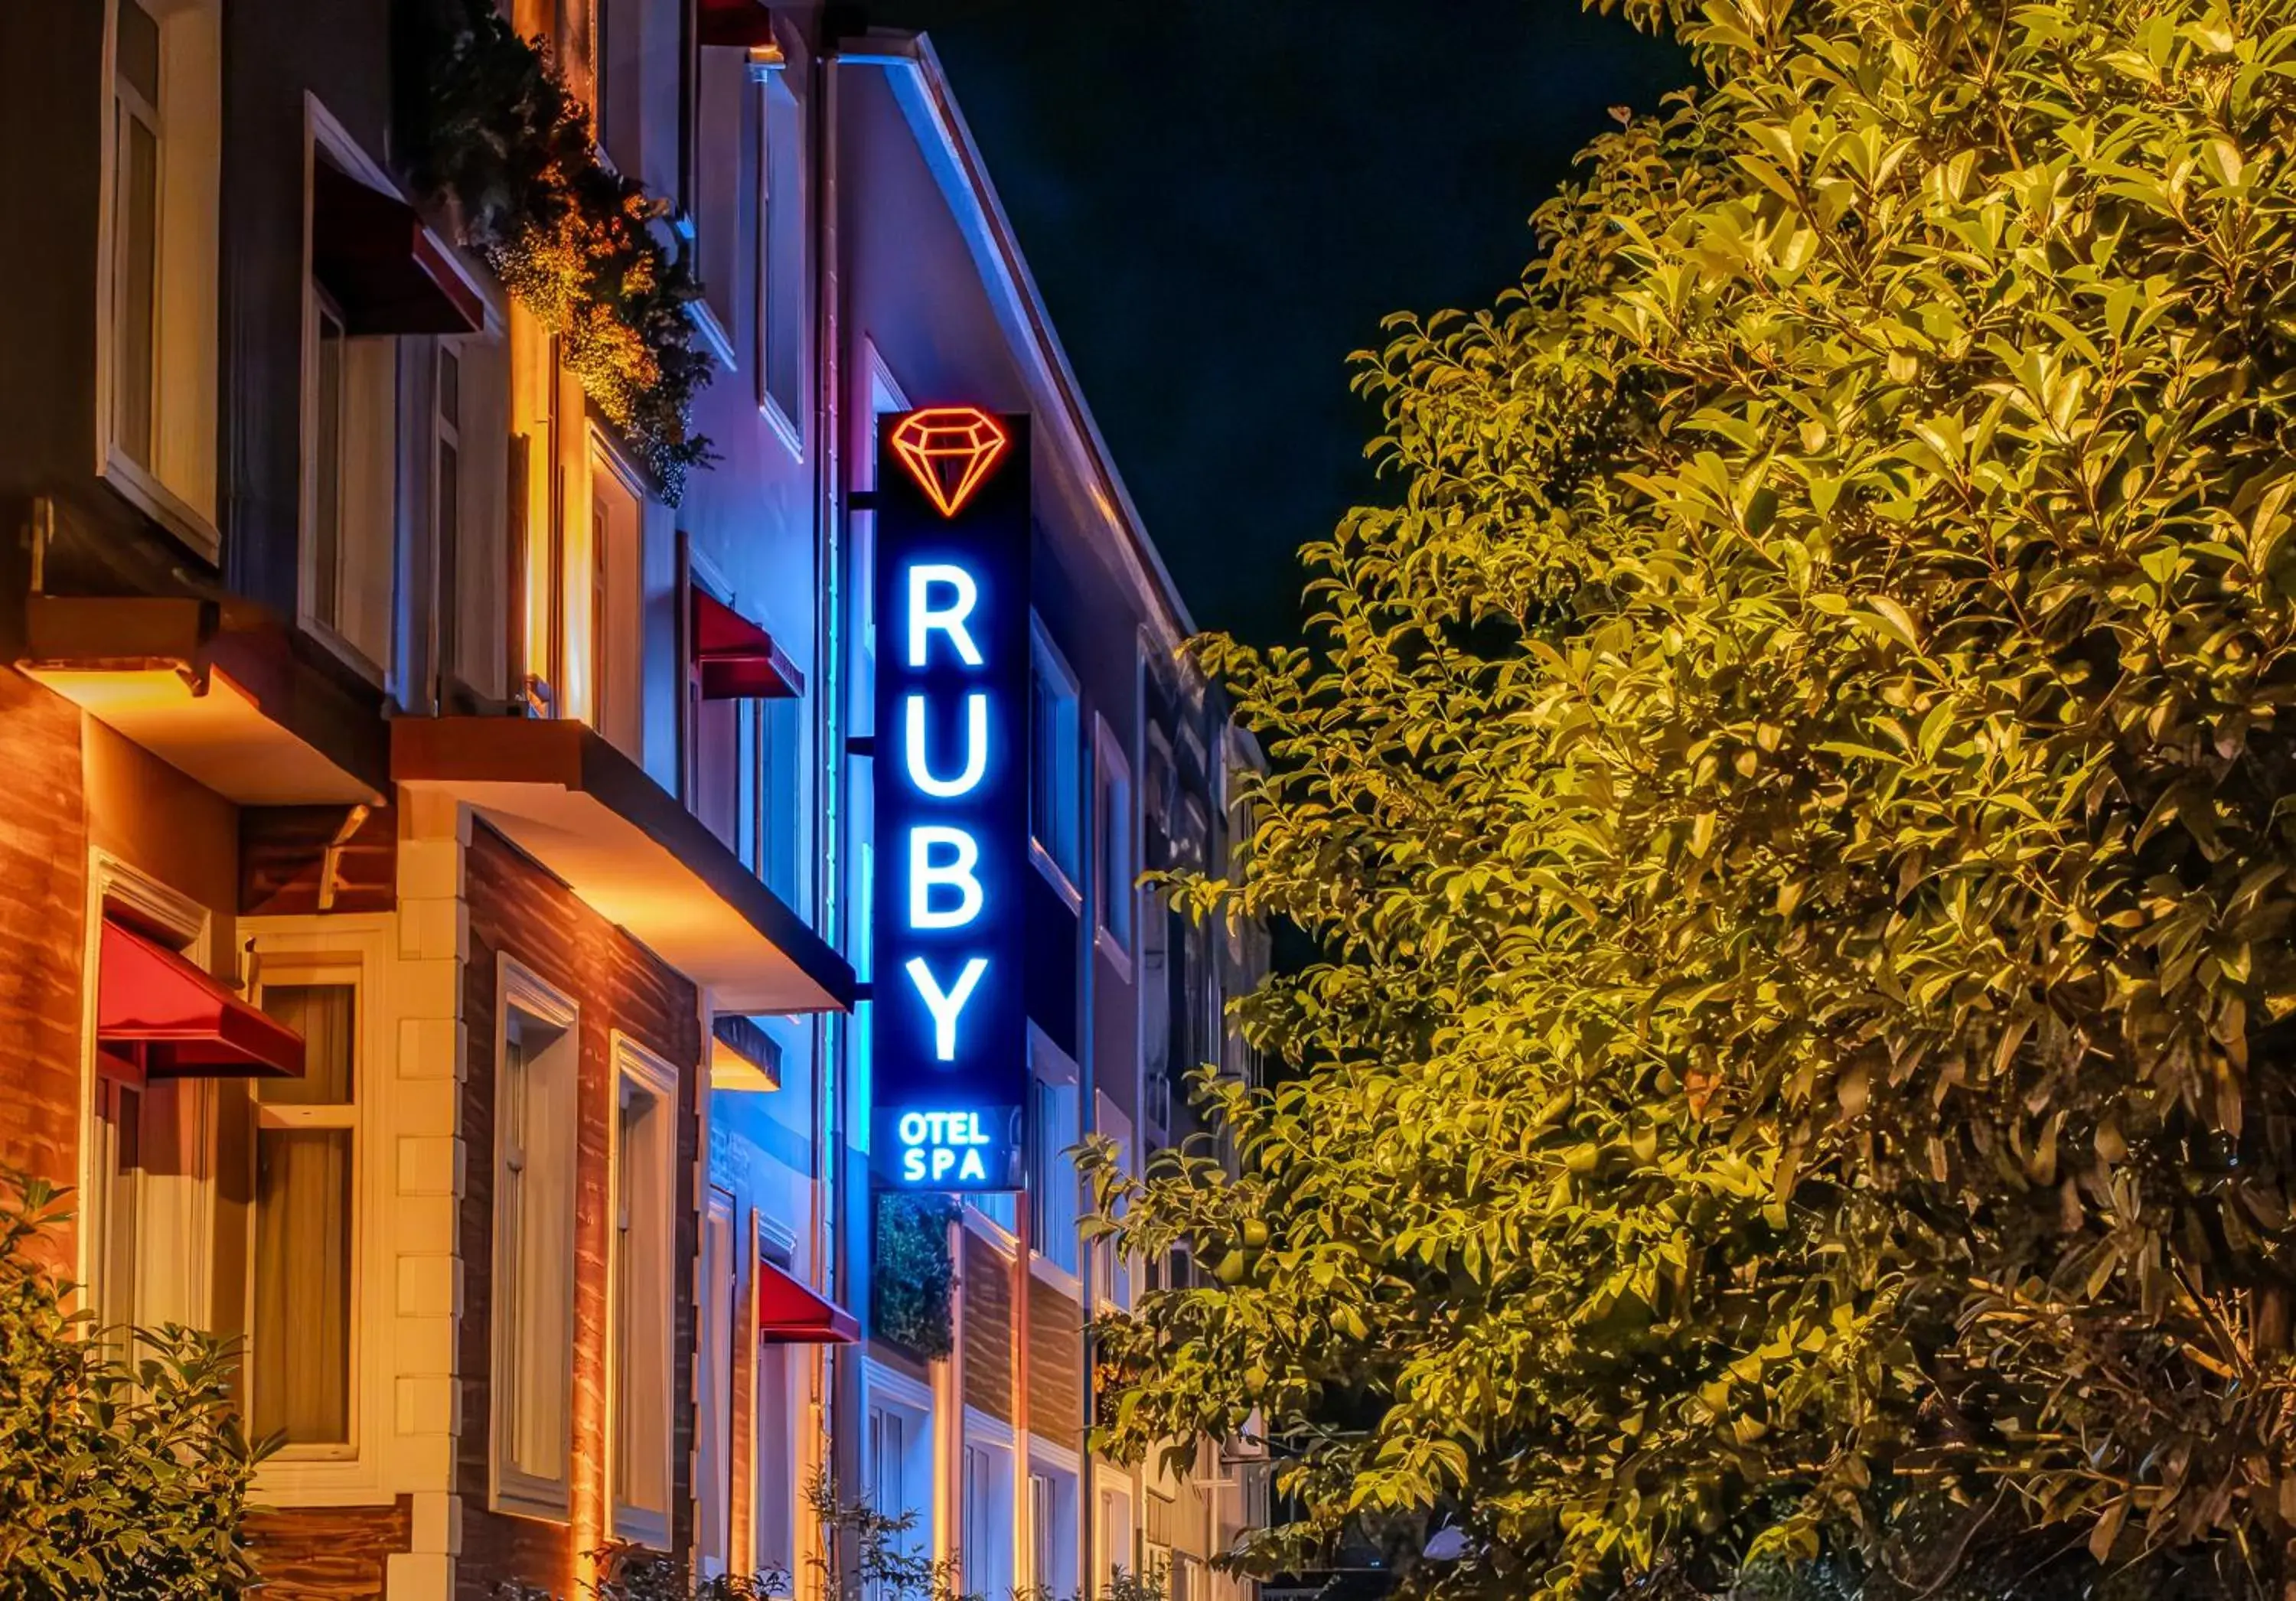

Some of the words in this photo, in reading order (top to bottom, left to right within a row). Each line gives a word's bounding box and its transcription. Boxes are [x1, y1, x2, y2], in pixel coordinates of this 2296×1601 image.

[906, 564, 988, 1061] RUBY
[899, 1112, 990, 1145] OTEL
[904, 1149, 986, 1181] SPA
